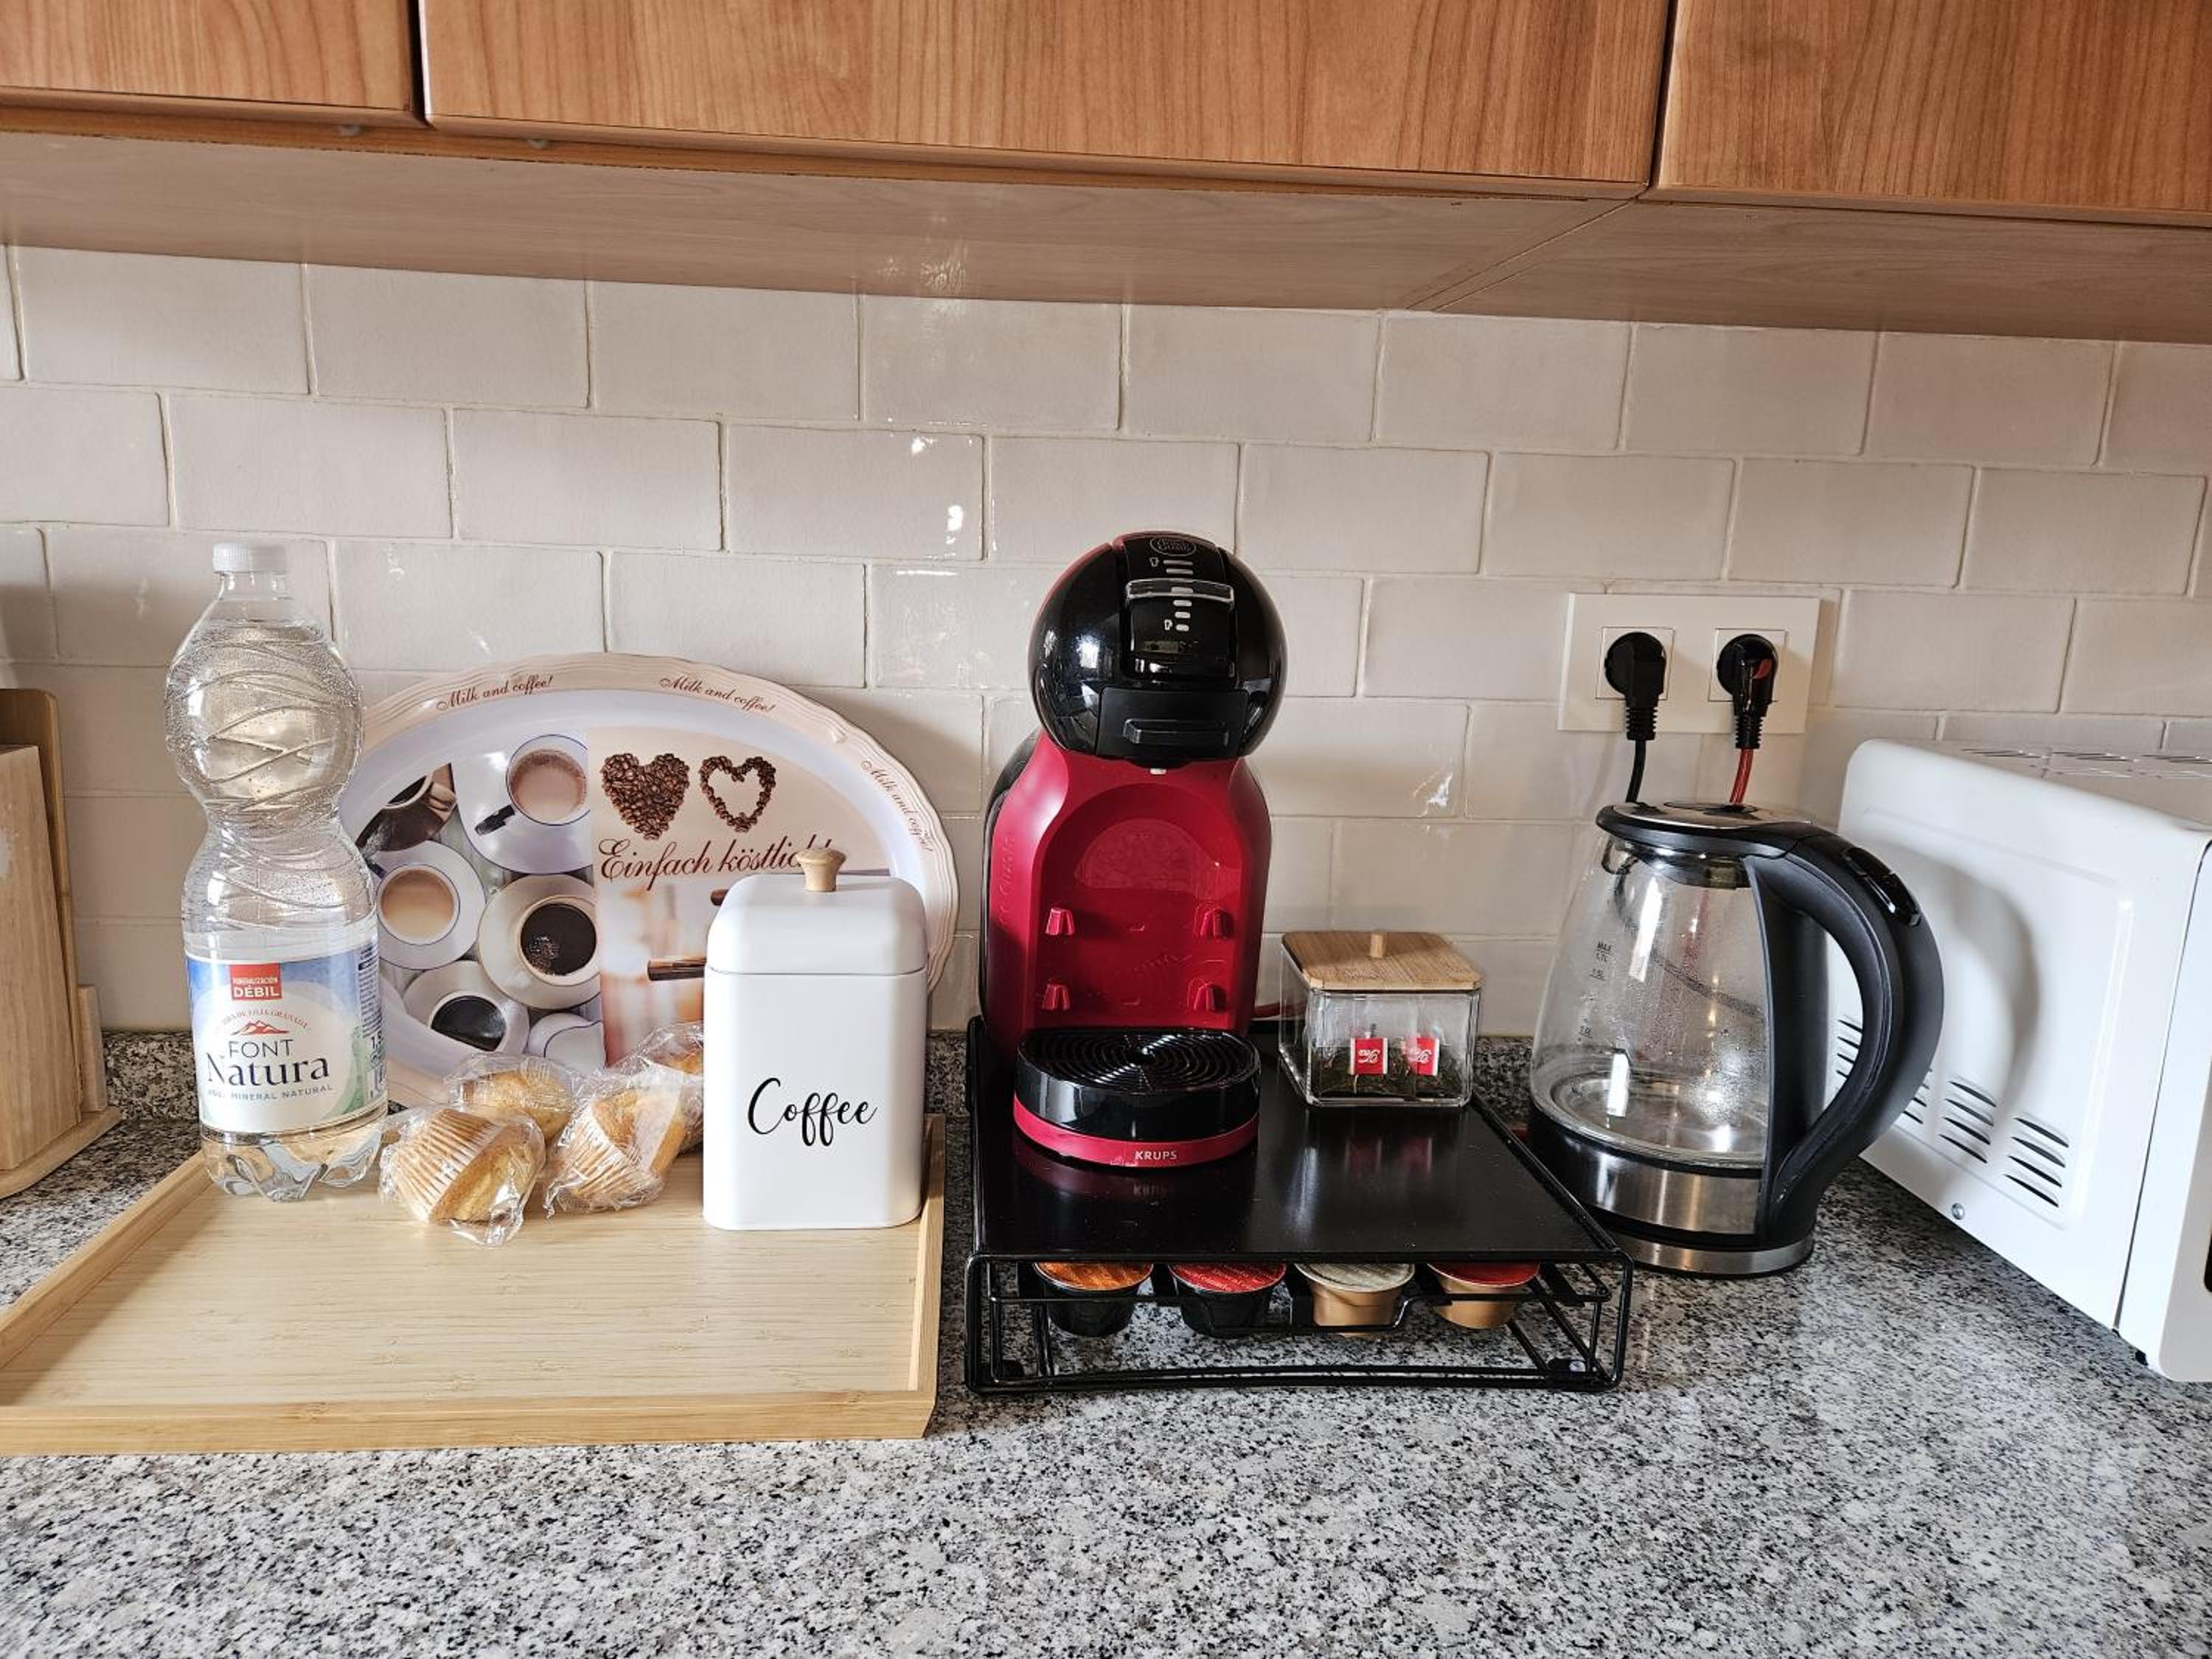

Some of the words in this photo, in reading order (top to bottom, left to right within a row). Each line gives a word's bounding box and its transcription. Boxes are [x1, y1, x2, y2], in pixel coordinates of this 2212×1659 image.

[437, 686, 479, 711] Milk
[483, 681, 509, 698] and
[512, 674, 554, 695] coffee!
[659, 676, 703, 694] Milk
[704, 689, 736, 700] and
[734, 696, 776, 712] coffee!
[861, 760, 897, 791] Milk
[891, 794, 919, 815] and
[598, 838, 714, 891] Einfach
[717, 834, 832, 872] köstlic
[234, 984, 280, 998] DÉBIL
[228, 1038, 294, 1059] FONT
[206, 1052, 330, 1087] Natura
[231, 1091, 278, 1101] MINERAL
[282, 1085, 335, 1099] NATURAL
[748, 1077, 878, 1147] Coffee
[1135, 1151, 1178, 1161] KRUPS
